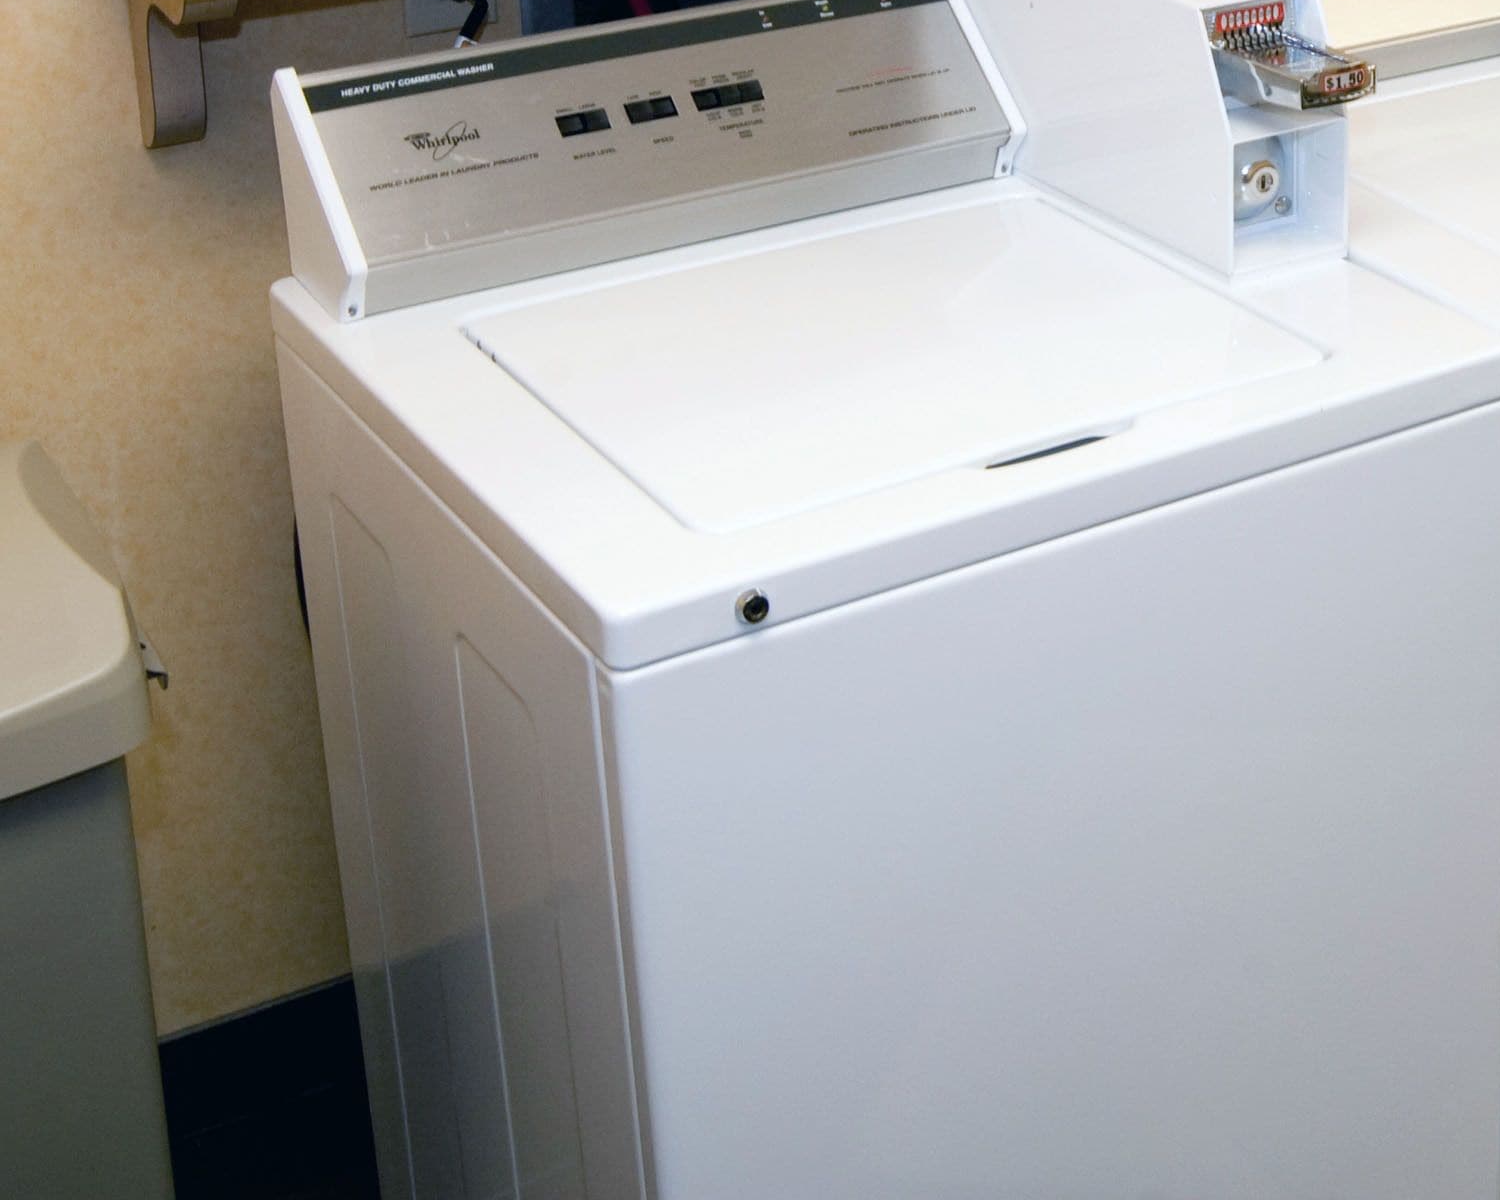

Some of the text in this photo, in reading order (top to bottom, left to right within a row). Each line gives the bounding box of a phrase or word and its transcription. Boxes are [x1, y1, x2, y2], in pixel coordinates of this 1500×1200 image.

[340, 62, 495, 98] HEAVY DUTY COMMERCIAL WASHER
[1325, 70, 1365, 90] $1.50
[410, 128, 481, 152] Whirlpool
[369, 151, 540, 193] WORLD LEADER IN LAUNDRY PRODUCTS
